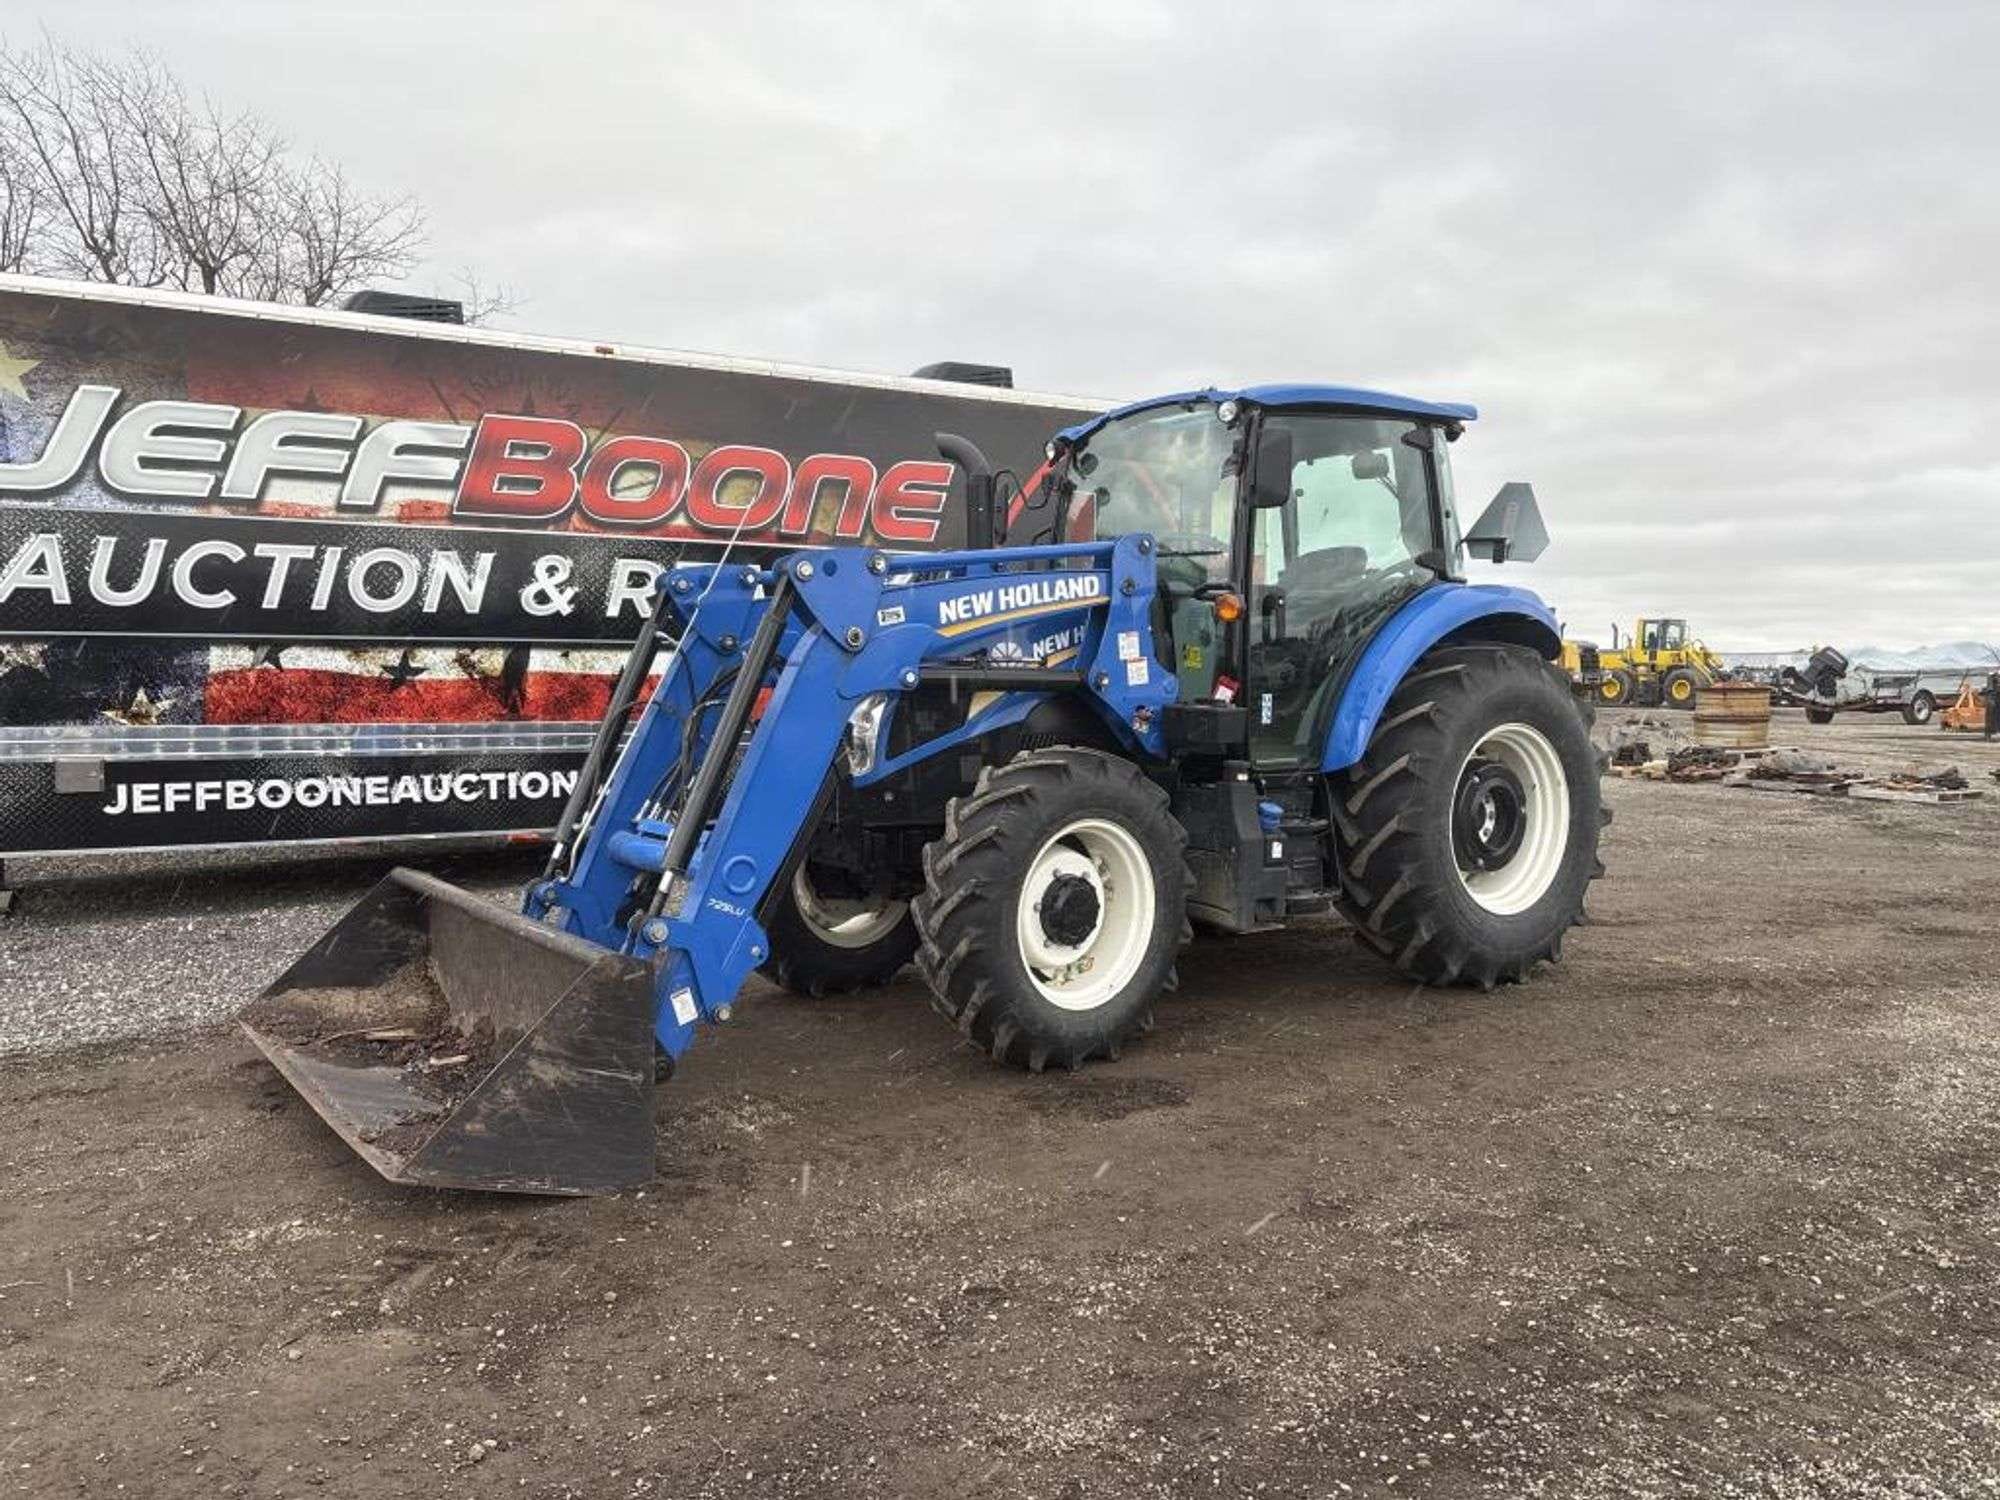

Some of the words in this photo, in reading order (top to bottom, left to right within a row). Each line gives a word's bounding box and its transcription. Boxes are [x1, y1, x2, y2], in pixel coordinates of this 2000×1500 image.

[0, 533, 497, 614] AUCTION
[520, 554, 579, 617] &
[939, 589, 994, 625] NEW
[998, 575, 1100, 612] HOLLAND
[1032, 628, 1070, 660] NEW
